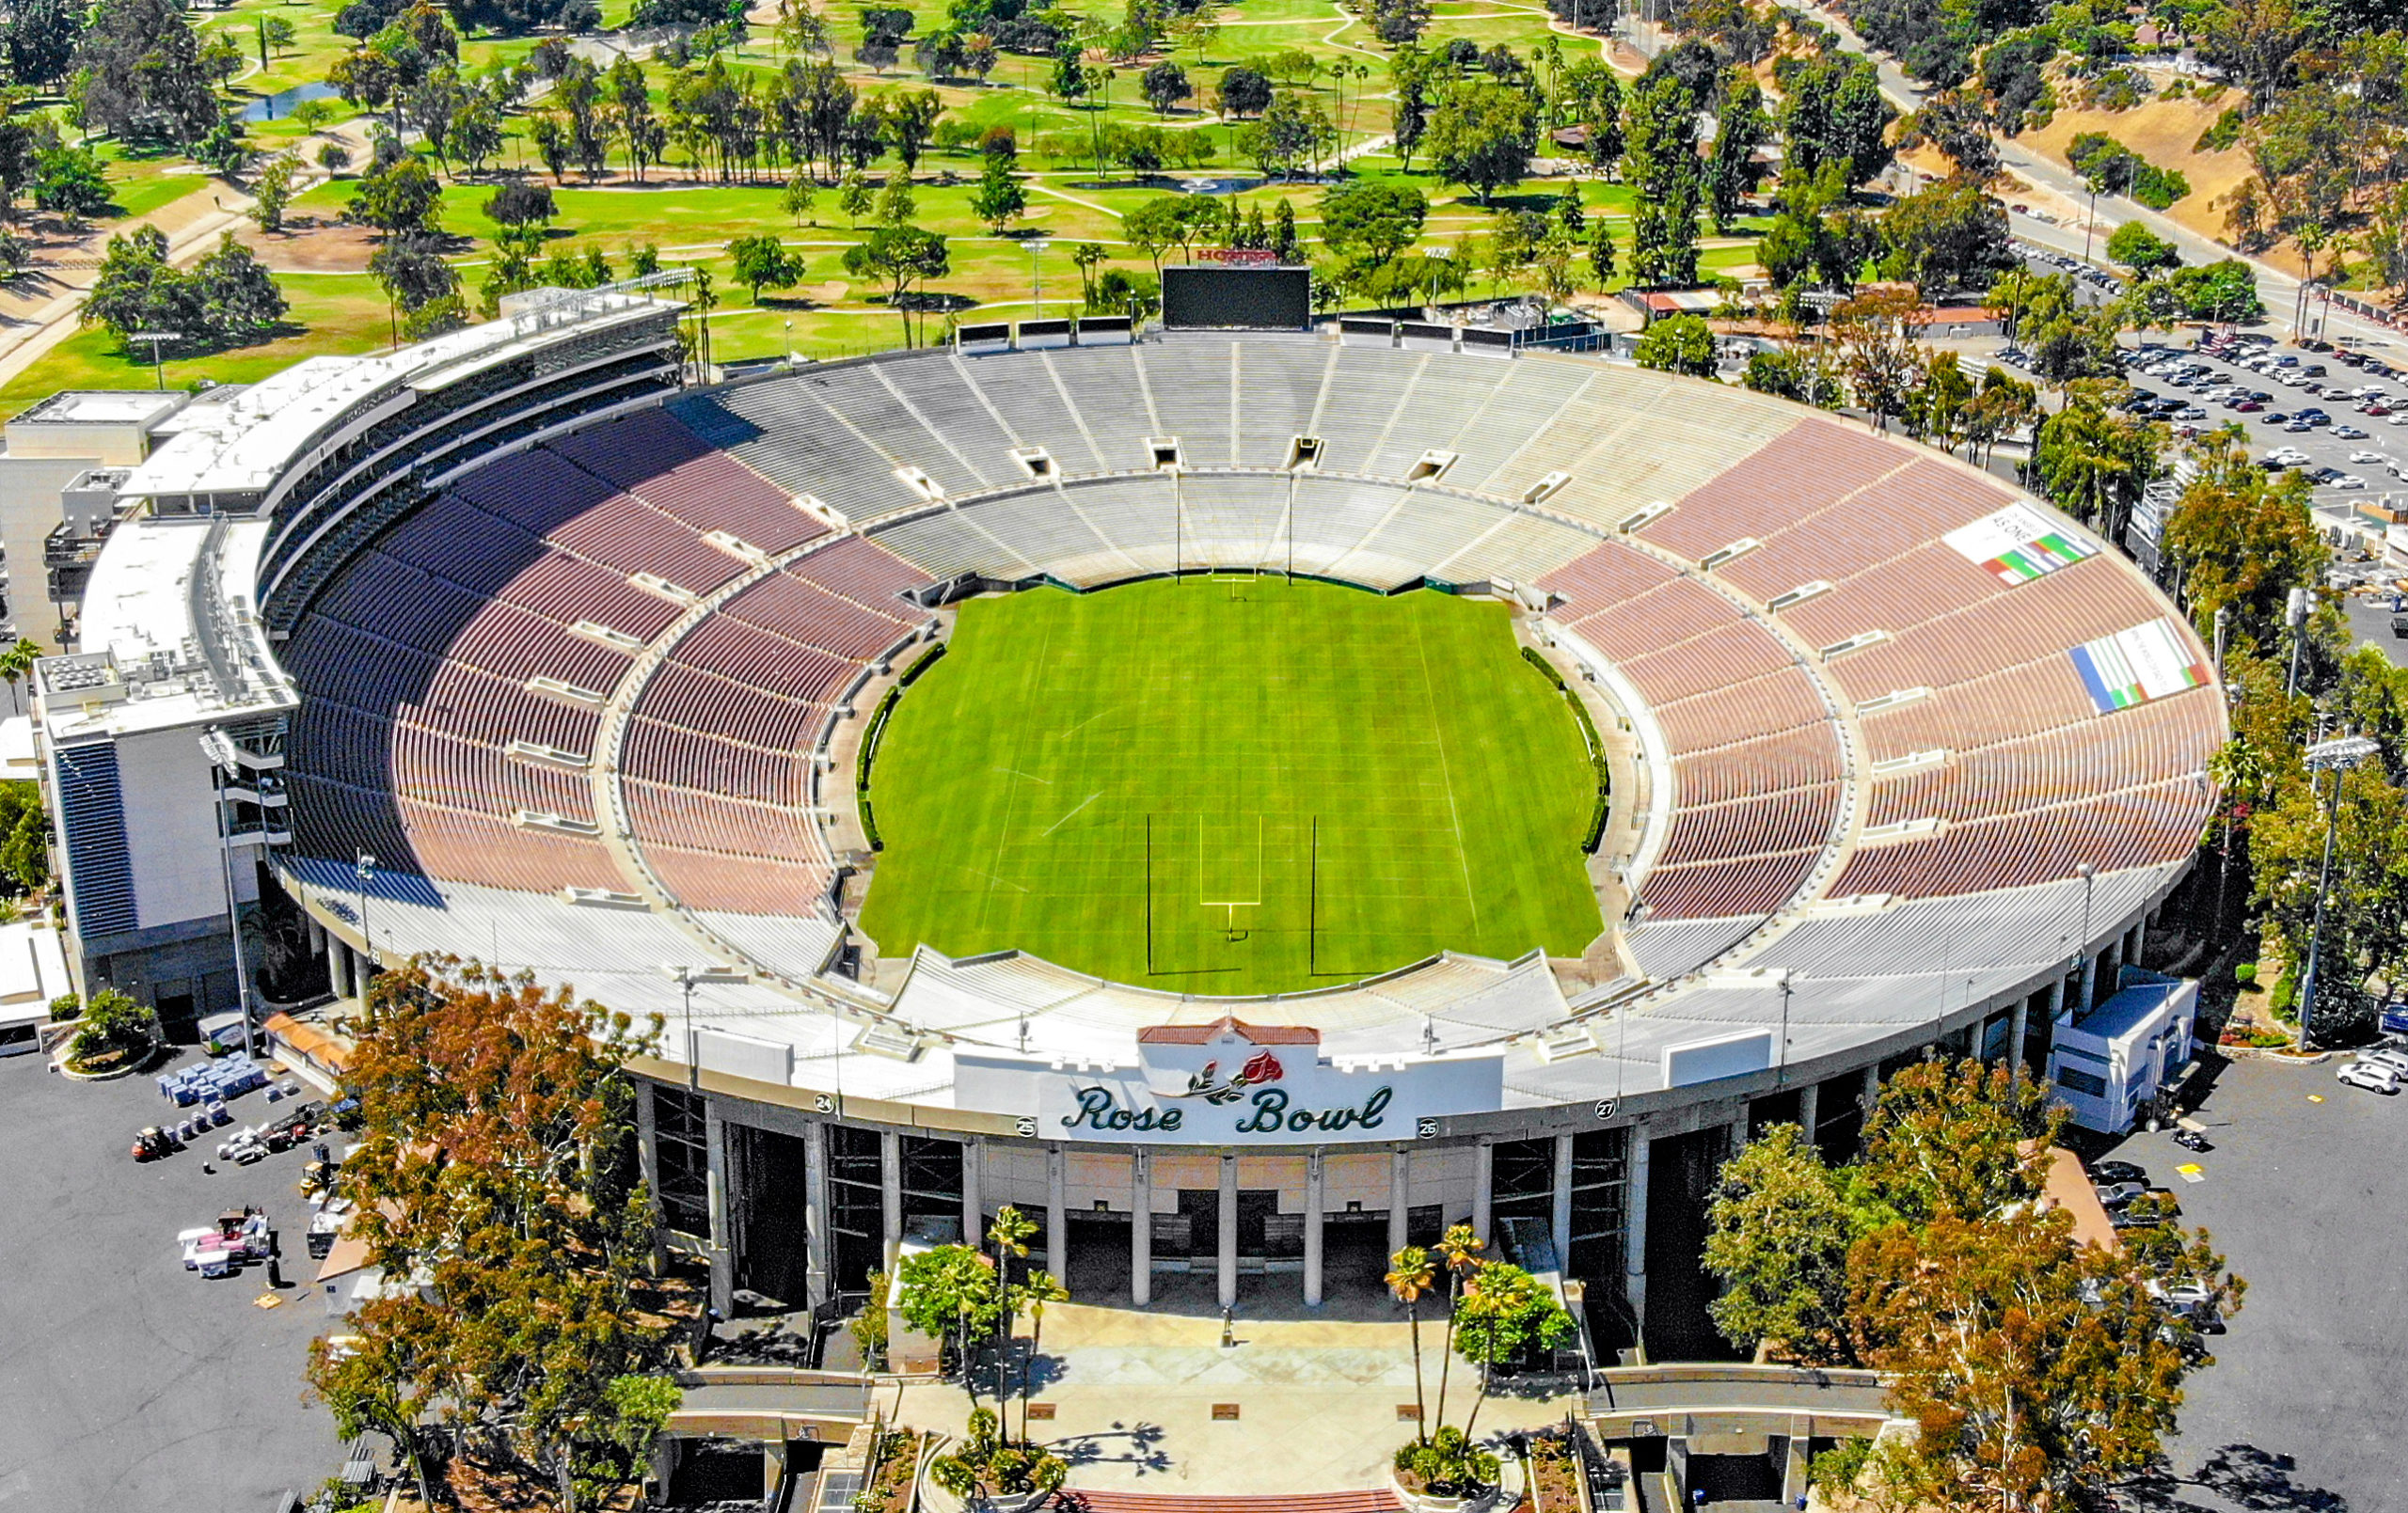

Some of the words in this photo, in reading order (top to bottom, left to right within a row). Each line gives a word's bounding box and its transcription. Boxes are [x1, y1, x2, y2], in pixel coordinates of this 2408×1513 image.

[816, 1096, 832, 1110] 24
[1061, 1086, 1183, 1131] Rose
[1235, 1085, 1393, 1133] Bowl
[1597, 1103, 1613, 1115] 27
[1018, 1120, 1035, 1133] 25
[1419, 1123, 1436, 1134] 26
